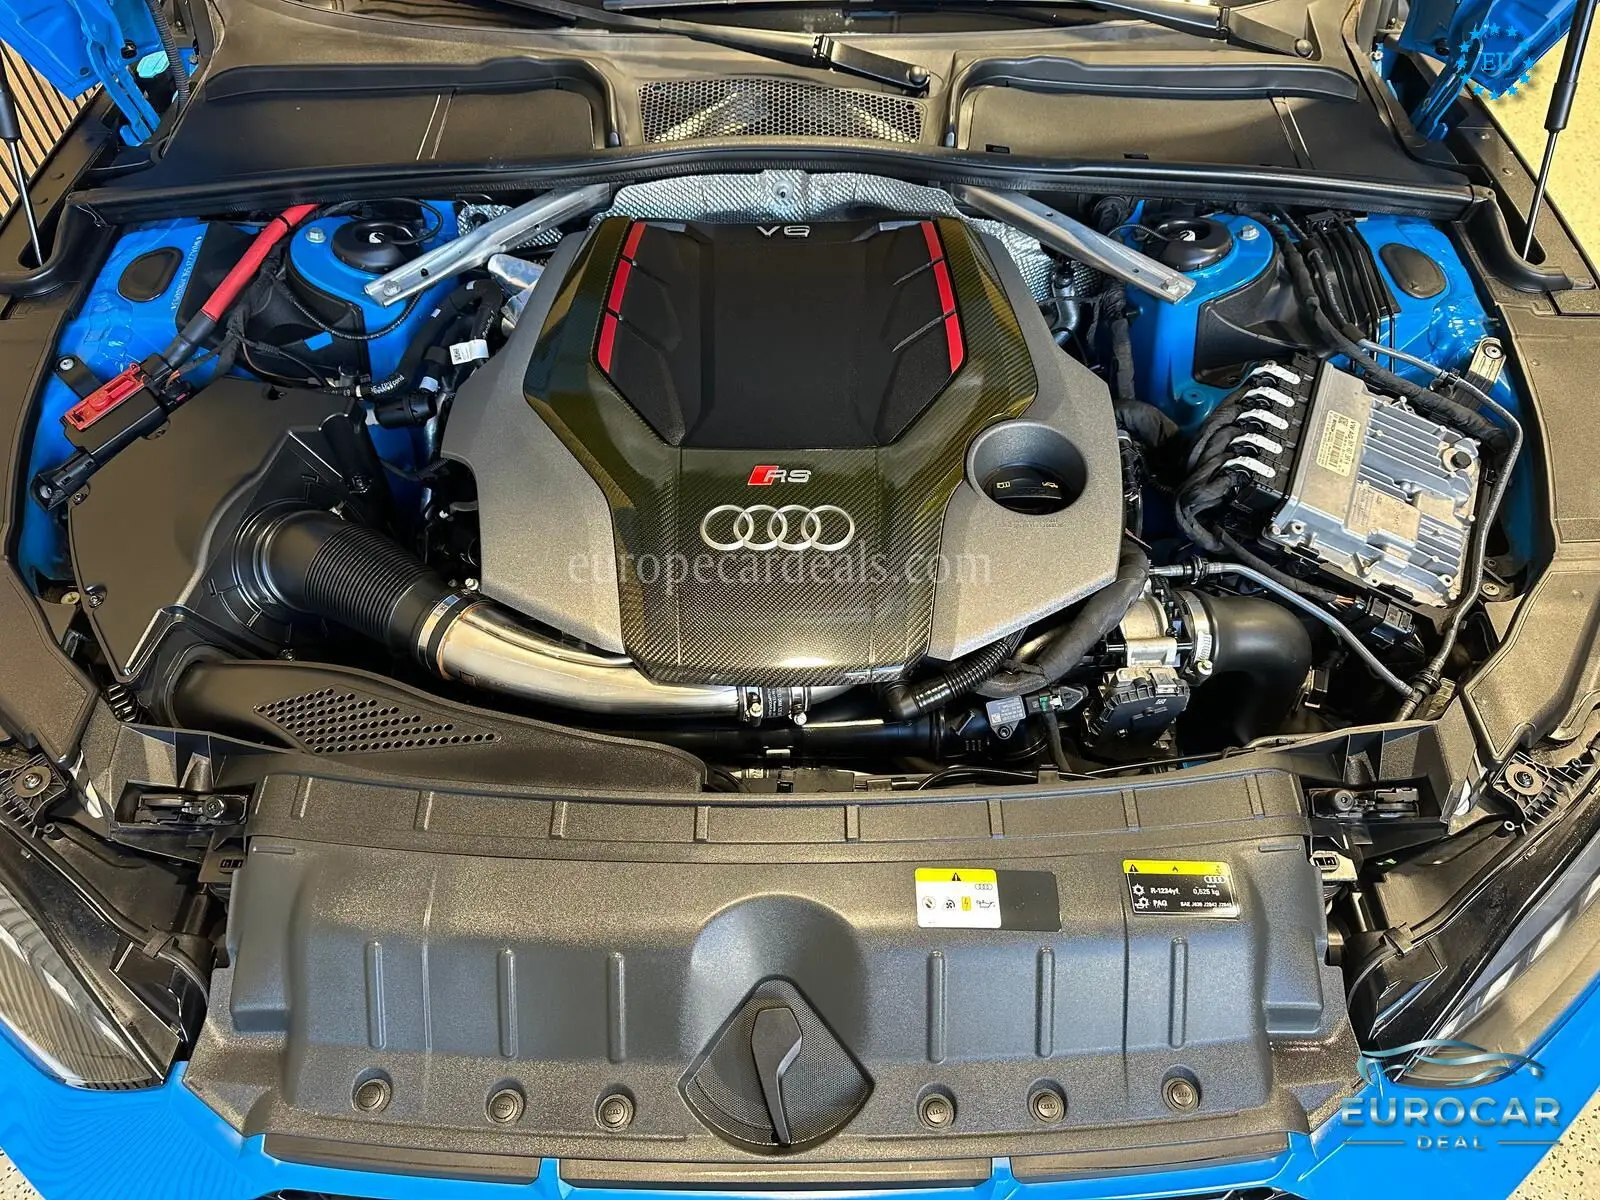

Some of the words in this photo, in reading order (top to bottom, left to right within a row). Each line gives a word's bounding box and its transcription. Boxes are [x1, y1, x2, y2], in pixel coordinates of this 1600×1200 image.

[756, 225, 811, 238] V6
[762, 468, 812, 484] RS
[1152, 899, 1168, 907] PAG
